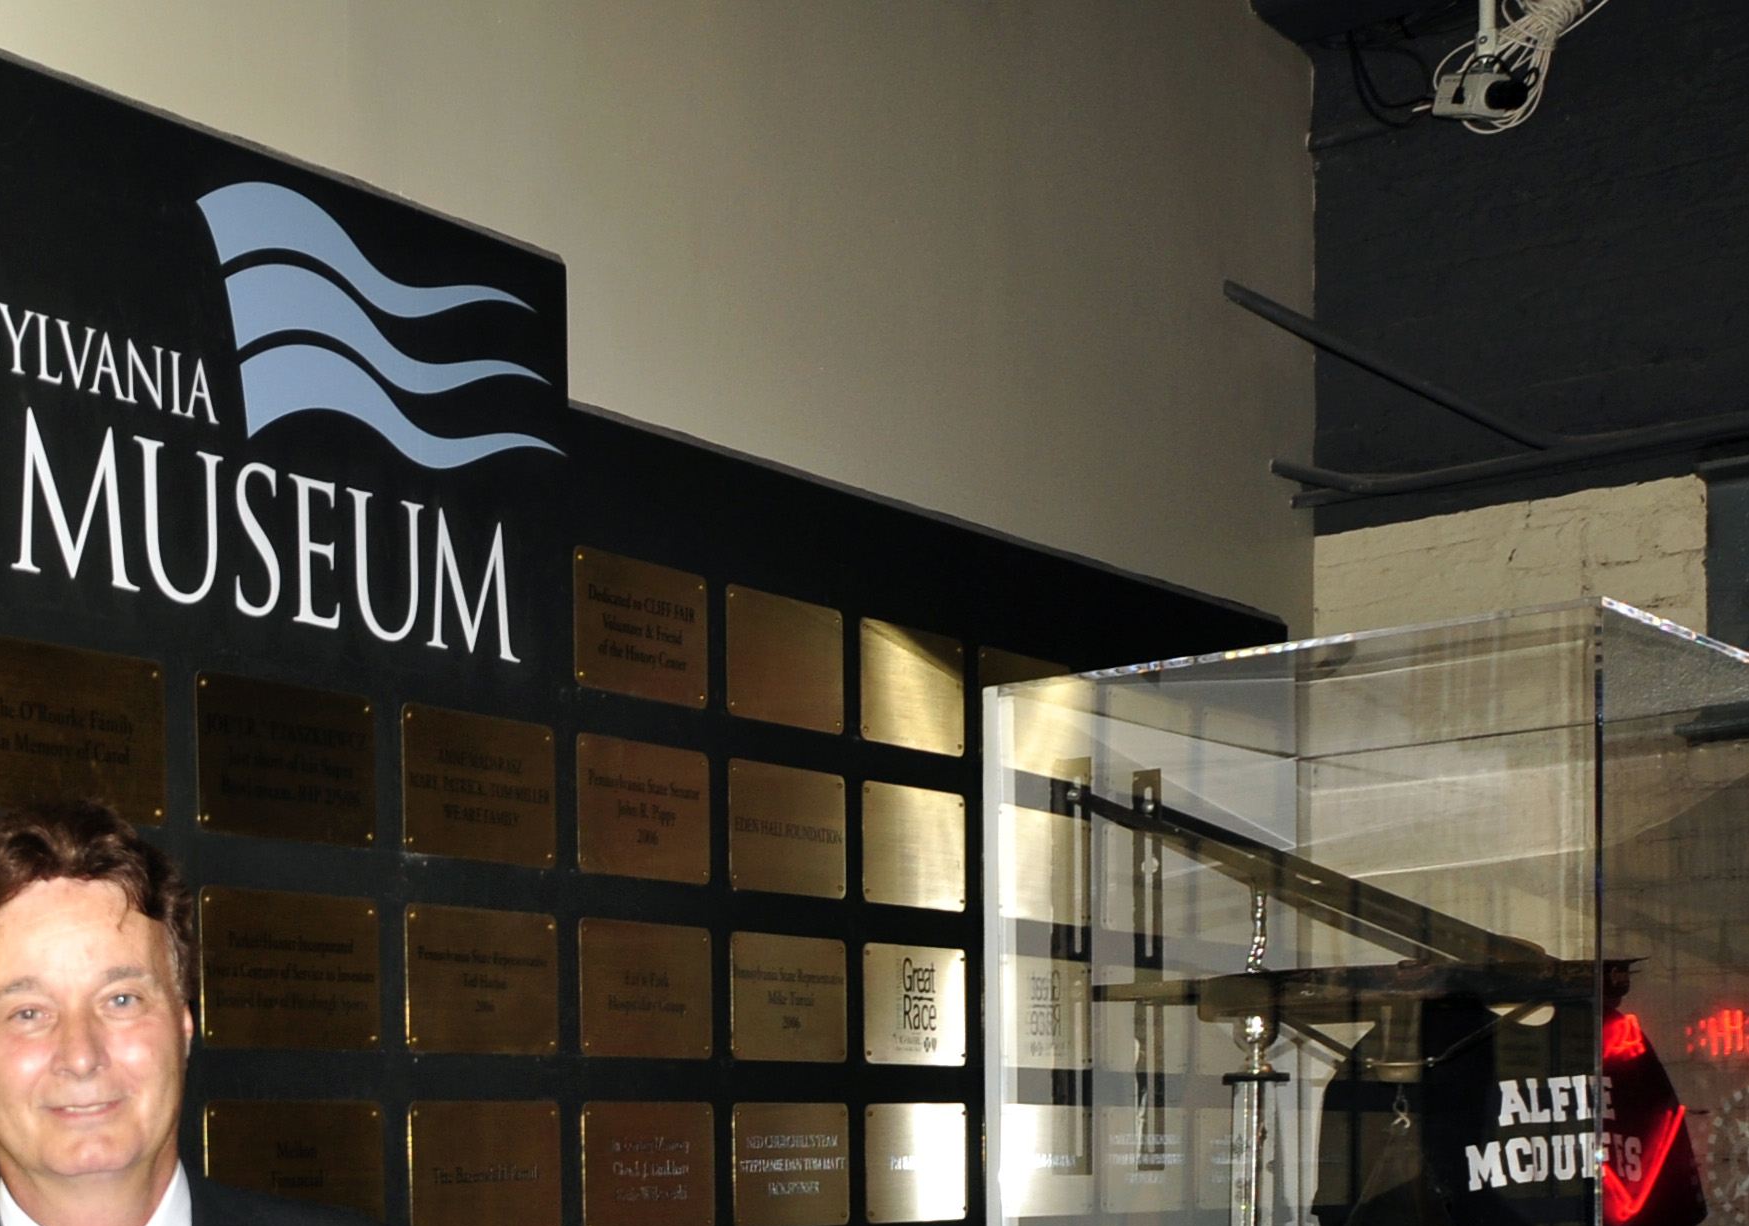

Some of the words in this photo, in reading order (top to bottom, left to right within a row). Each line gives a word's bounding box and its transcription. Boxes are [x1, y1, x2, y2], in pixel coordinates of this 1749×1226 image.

[10, 406, 522, 662] MUSEUM
[903, 957, 936, 993] Great
[903, 994, 937, 1031] Race
[1498, 1075, 1615, 1127] ALFIE
